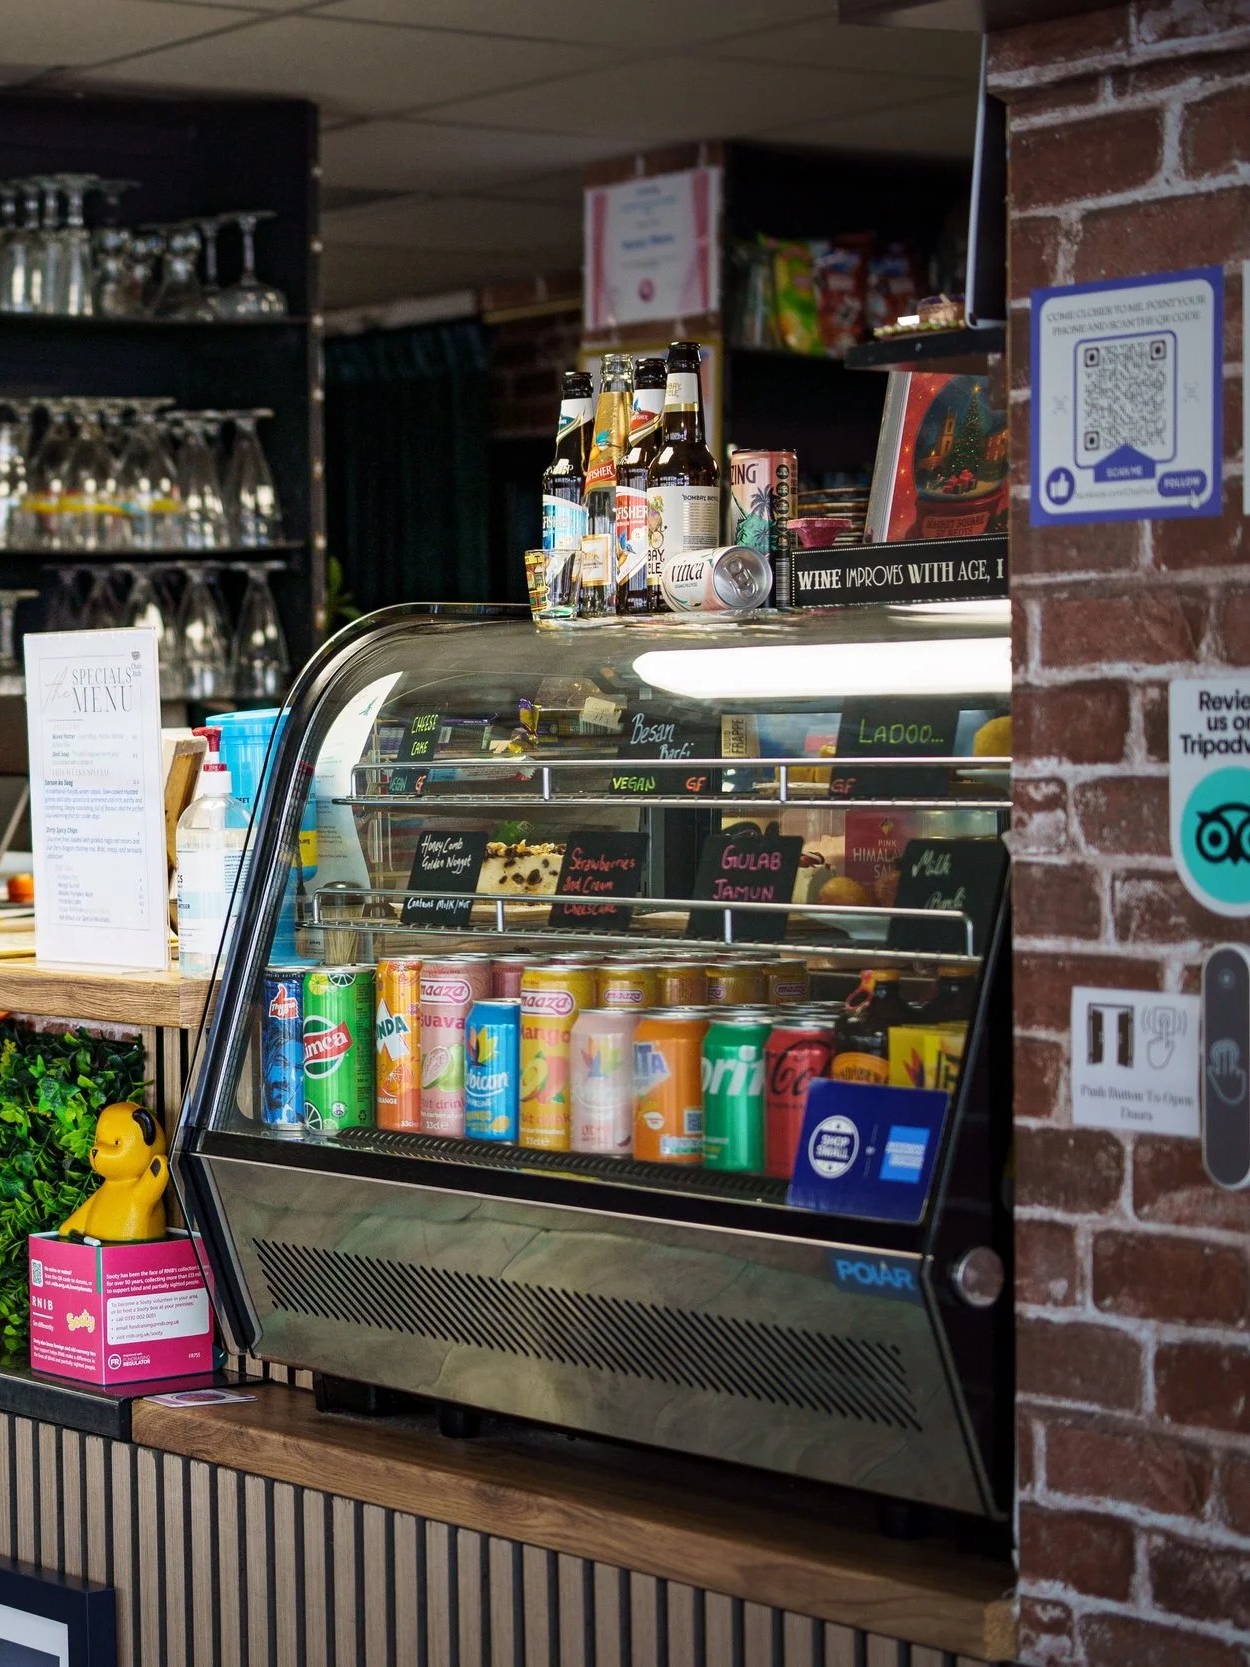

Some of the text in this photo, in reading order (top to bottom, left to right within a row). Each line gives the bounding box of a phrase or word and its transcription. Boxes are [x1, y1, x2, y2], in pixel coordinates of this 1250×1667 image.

[671, 560, 705, 582] vinca
[797, 568, 842, 590] WINE
[845, 564, 904, 587] IMPROVES
[907, 561, 955, 584] WITH
[957, 559, 991, 583] AGE,
[72, 666, 132, 686] SPECIALS
[72, 685, 132, 713] MENU
[410, 714, 439, 735] CHEESE
[630, 712, 676, 745] Besan
[1206, 715, 1227, 731] us
[731, 718, 744, 755] FRAPPE
[410, 741, 429, 757] CAKE
[612, 775, 707, 793] VEGAN GF
[830, 777, 857, 795] GF
[878, 839, 897, 847] PINK
[421, 855, 444, 871] Golden
[606, 991, 641, 1002] maaza
[376, 1015, 409, 1040] NDA
[304, 1031, 349, 1059] imca
[1080, 1083, 1106, 1099] Push
[1107, 1085, 1144, 1101] Button
[1162, 1091, 1194, 1109] Open
[821, 1134, 850, 1148] SHOP
[816, 1145, 849, 1160] SMALL
[834, 1258, 916, 1290] POLAR
[32, 1295, 53, 1311] RNIB
[123, 1359, 150, 1367] REGULATOR
